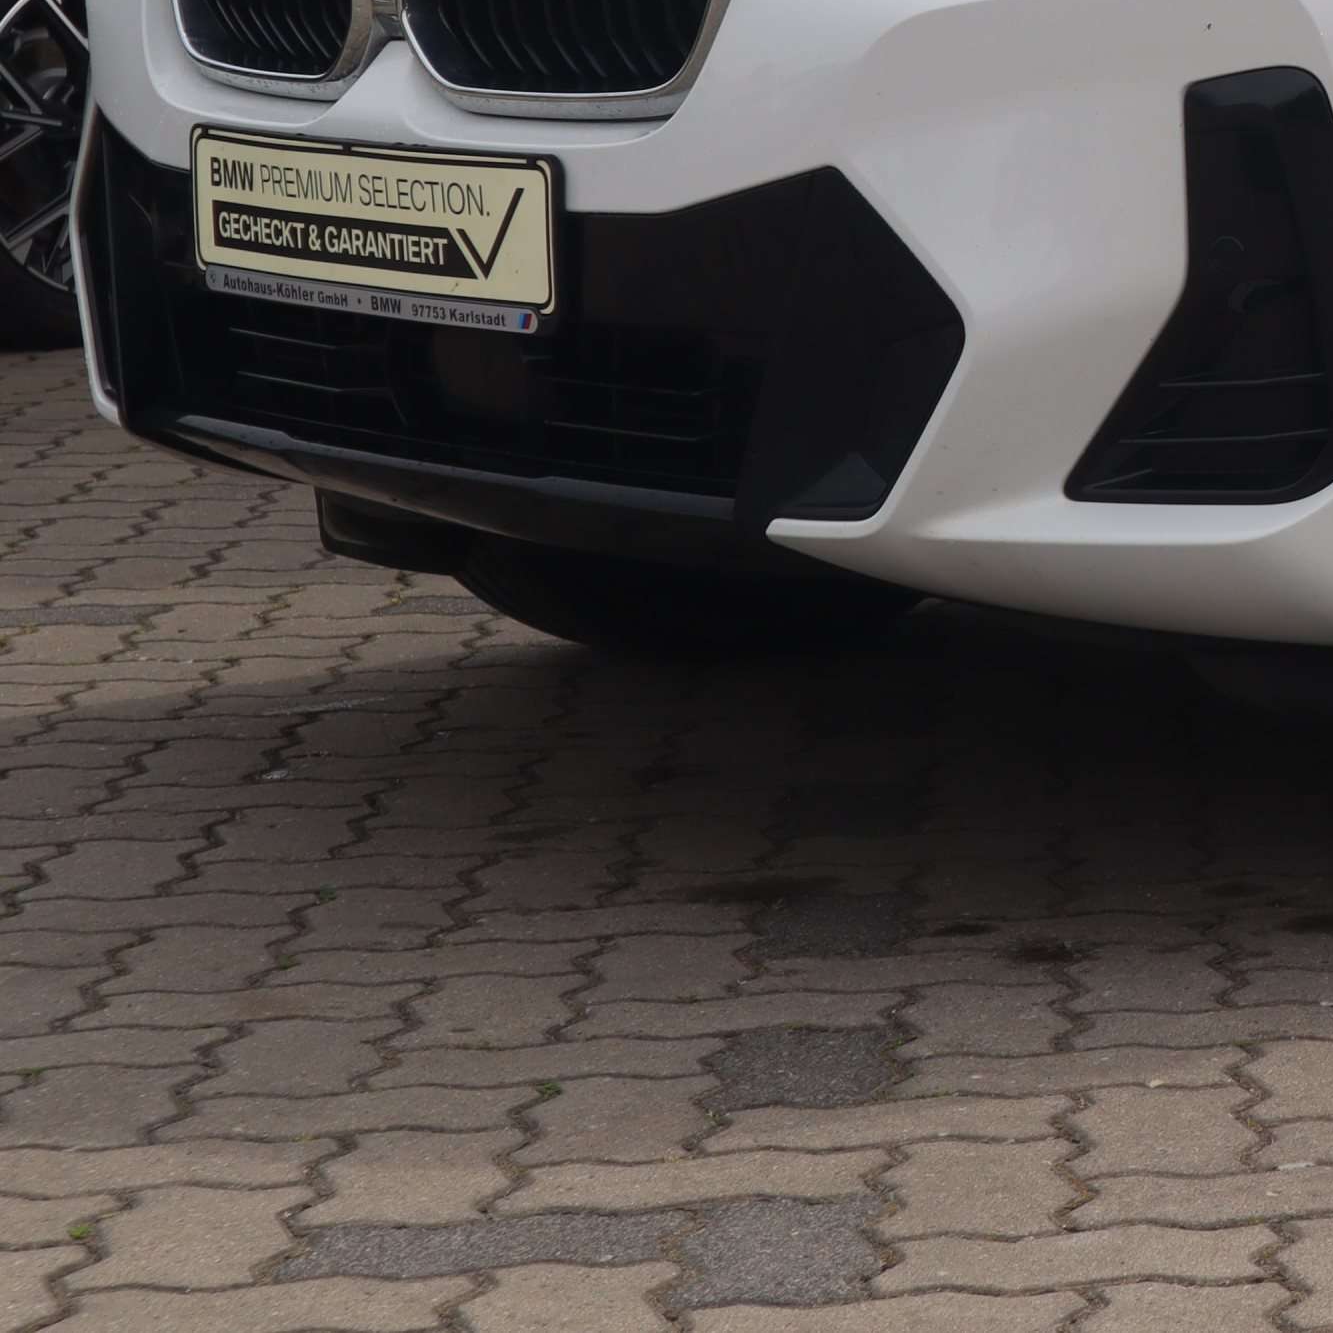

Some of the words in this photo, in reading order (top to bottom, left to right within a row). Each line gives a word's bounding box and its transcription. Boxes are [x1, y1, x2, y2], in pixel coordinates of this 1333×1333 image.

[209, 156, 254, 192] BMW
[260, 164, 353, 205] PREMIUM
[358, 173, 491, 217] SELECTION.
[218, 211, 305, 250] GECHECKT
[308, 225, 322, 252] &
[324, 225, 448, 266] GARANTIERT
[223, 273, 315, 303] Autohaus-Köhler
[317, 290, 349, 308] GmbH
[370, 294, 402, 315] BMW
[411, 303, 447, 321] 97753
[449, 308, 507, 327] Karlstadt
